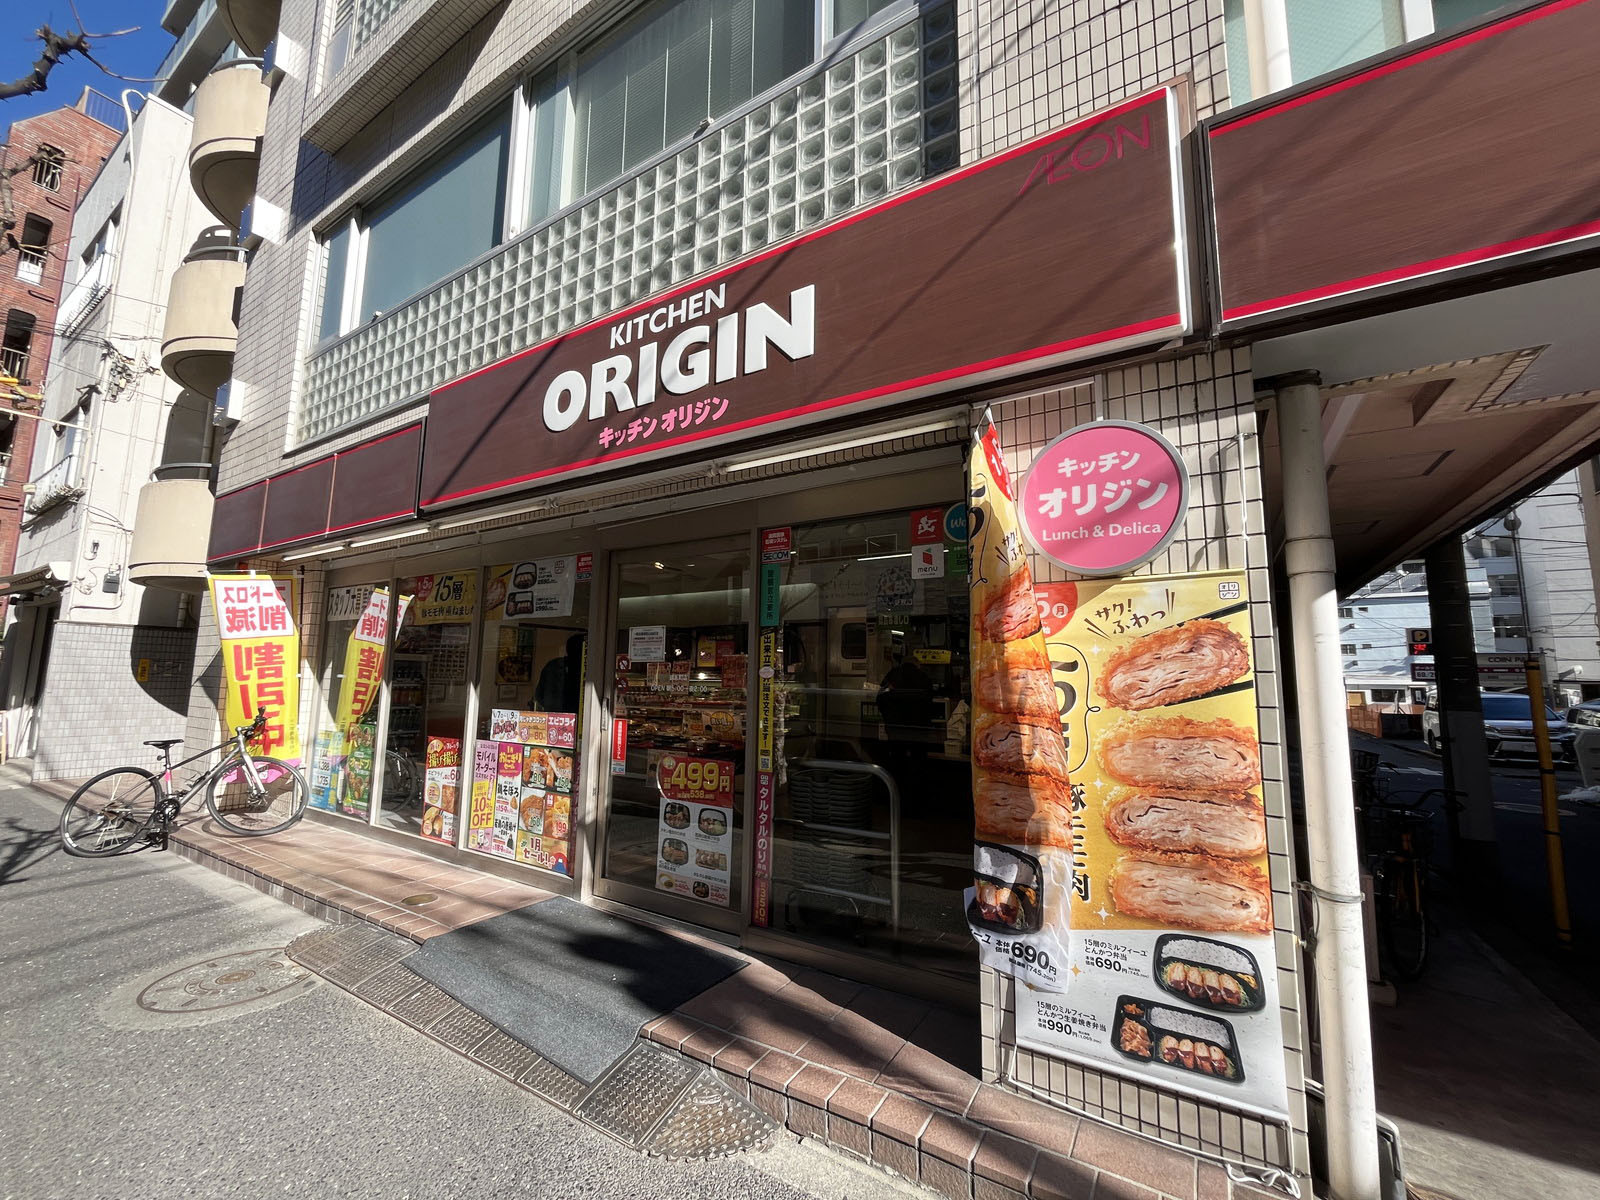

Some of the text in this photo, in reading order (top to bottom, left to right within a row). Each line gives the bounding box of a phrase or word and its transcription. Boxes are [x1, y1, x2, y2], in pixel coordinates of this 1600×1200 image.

[610, 282, 727, 349] KITCHEN
[543, 283, 816, 433] ORIGIN
[599, 397, 730, 449] キッチン オリジン
[1057, 450, 1141, 478] キッチン
[1038, 478, 1169, 519] オリジン
[1042, 521, 1162, 542] Lunch & Delica
[763, 551, 790, 561] SECOM
[917, 566, 938, 574] menu
[1094, 598, 1133, 621] サク!
[1112, 610, 1167, 634] ふわっ
[1414, 630, 1427, 641] P
[548, 716, 576, 727] エビフライ
[472, 813, 493, 827] OFF
